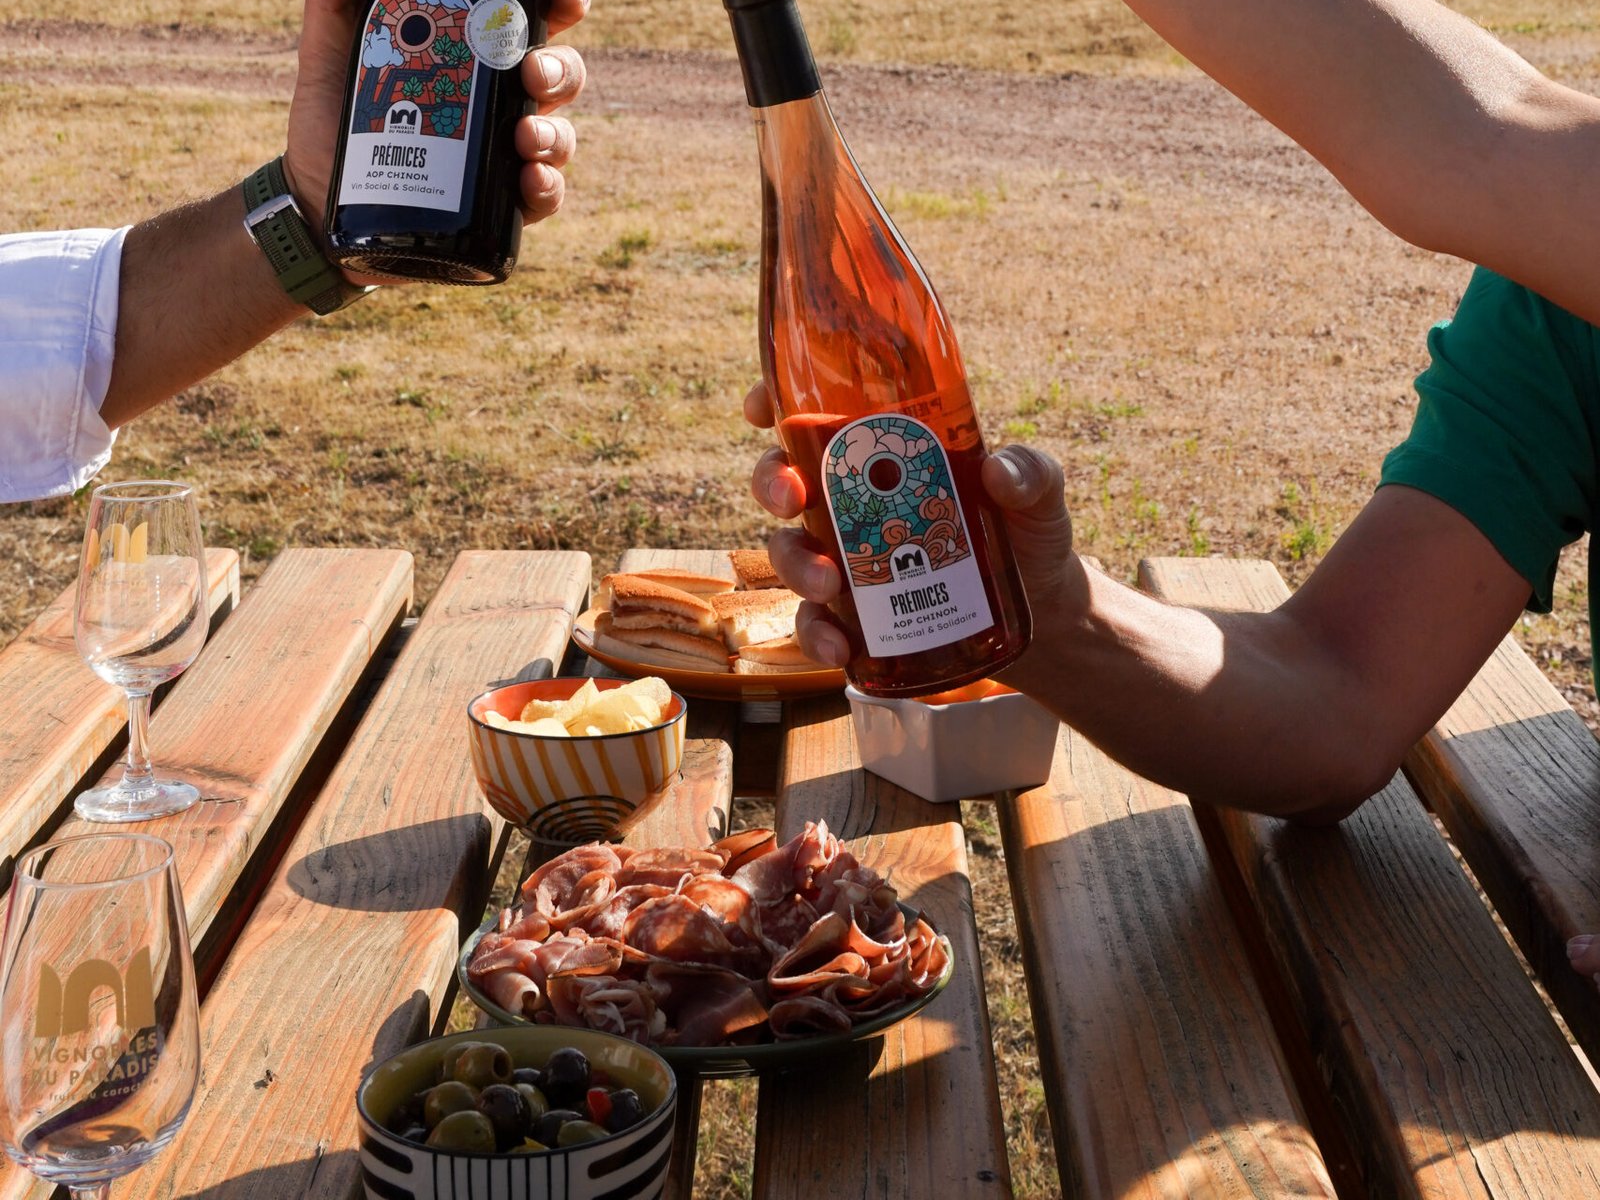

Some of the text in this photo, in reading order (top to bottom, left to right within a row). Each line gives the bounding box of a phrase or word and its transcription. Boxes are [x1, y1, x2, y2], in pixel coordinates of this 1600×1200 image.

[371, 142, 427, 168] PRÉMICES
[365, 182, 391, 191] Social
[402, 184, 445, 195] Solidaire
[387, 171, 429, 181] CHINON
[890, 582, 949, 616] PRÉMICES
[879, 611, 977, 642] Vin Social & Solidaire
[893, 605, 958, 629] AOP CHINON
